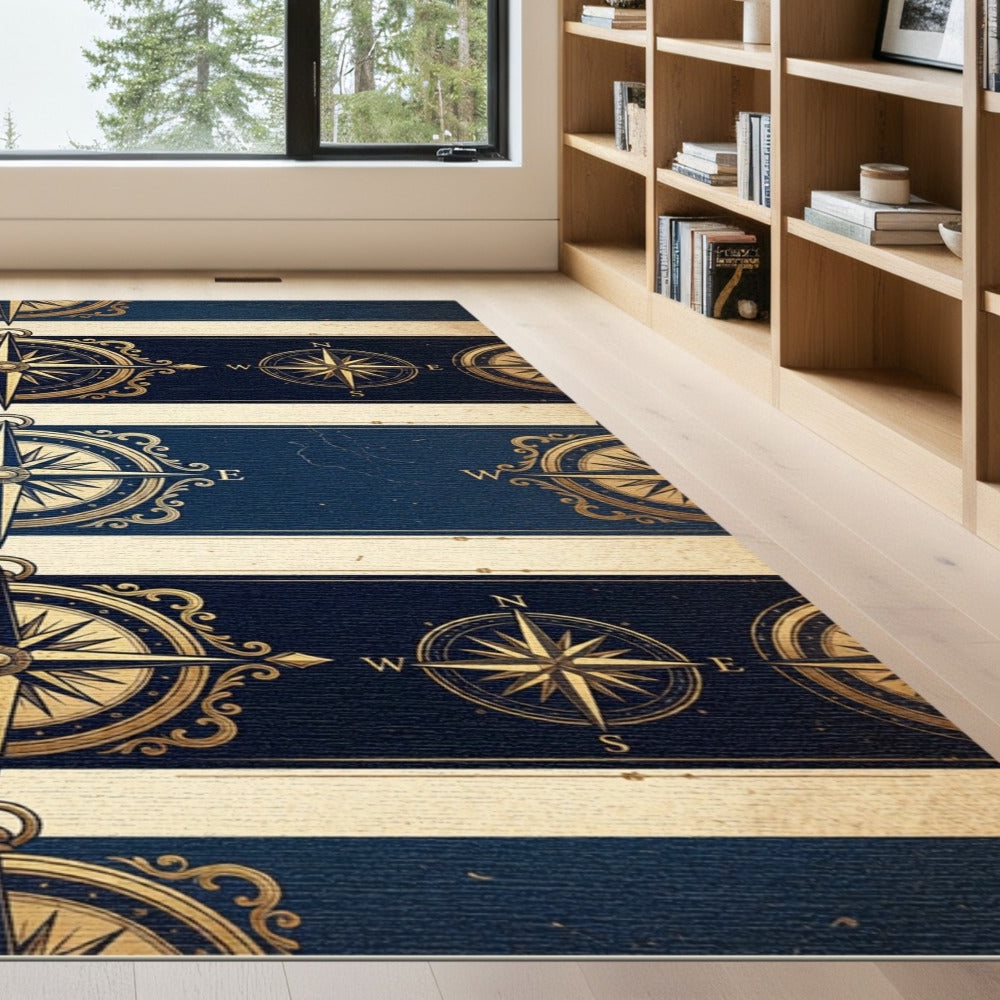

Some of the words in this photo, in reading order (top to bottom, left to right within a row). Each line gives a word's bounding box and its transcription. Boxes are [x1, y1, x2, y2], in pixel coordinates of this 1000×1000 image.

[215, 469, 244, 481] E
[459, 469, 502, 481] W
[491, 594, 527, 608] N
[361, 657, 405, 672] W
[711, 657, 744, 673] E
[599, 734, 631, 753] S
